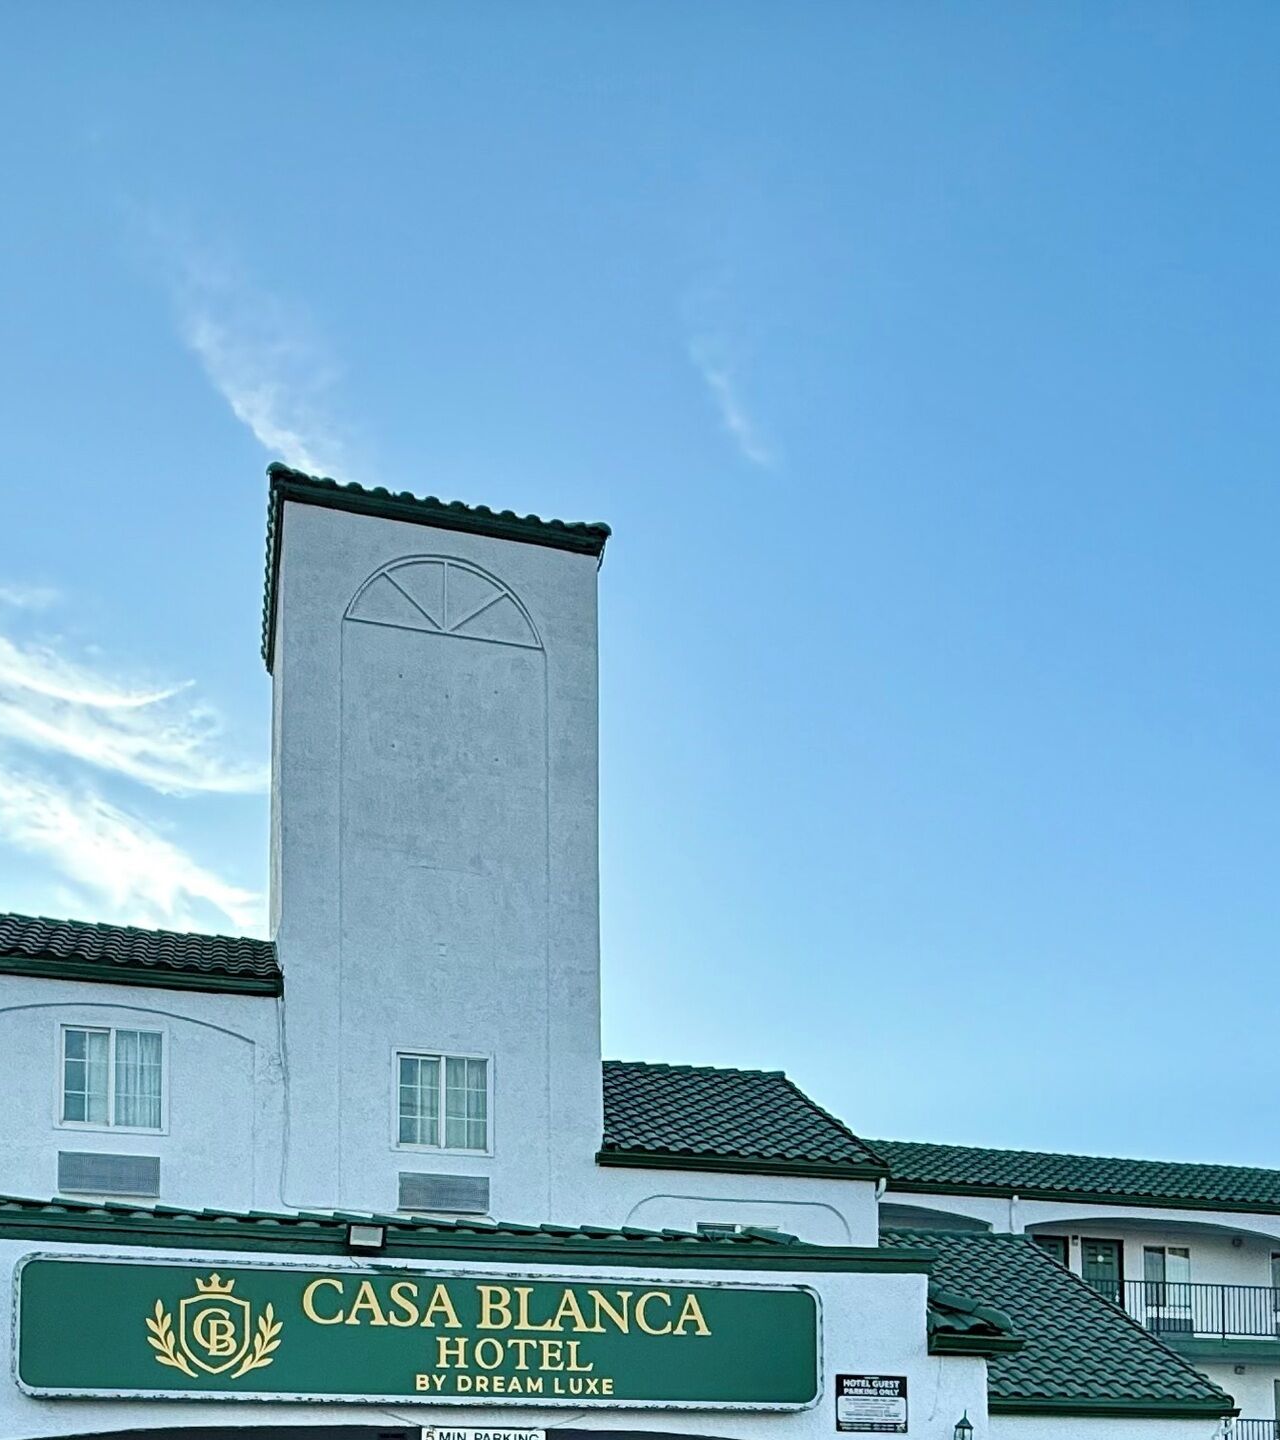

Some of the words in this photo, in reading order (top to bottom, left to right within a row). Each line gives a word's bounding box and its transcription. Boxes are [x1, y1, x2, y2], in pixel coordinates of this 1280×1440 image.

[302, 1278, 463, 1328] CASA
[477, 1285, 712, 1336] BLANCA
[435, 1336, 595, 1372] HOTEL
[415, 1374, 447, 1391] BY
[457, 1375, 543, 1393] DREAM
[554, 1377, 614, 1395] LUXE
[843, 1379, 871, 1388] HOTEL
[872, 1380, 900, 1389] GUEST
[843, 1388, 878, 1396] PARKING
[879, 1389, 900, 1397] ONLY
